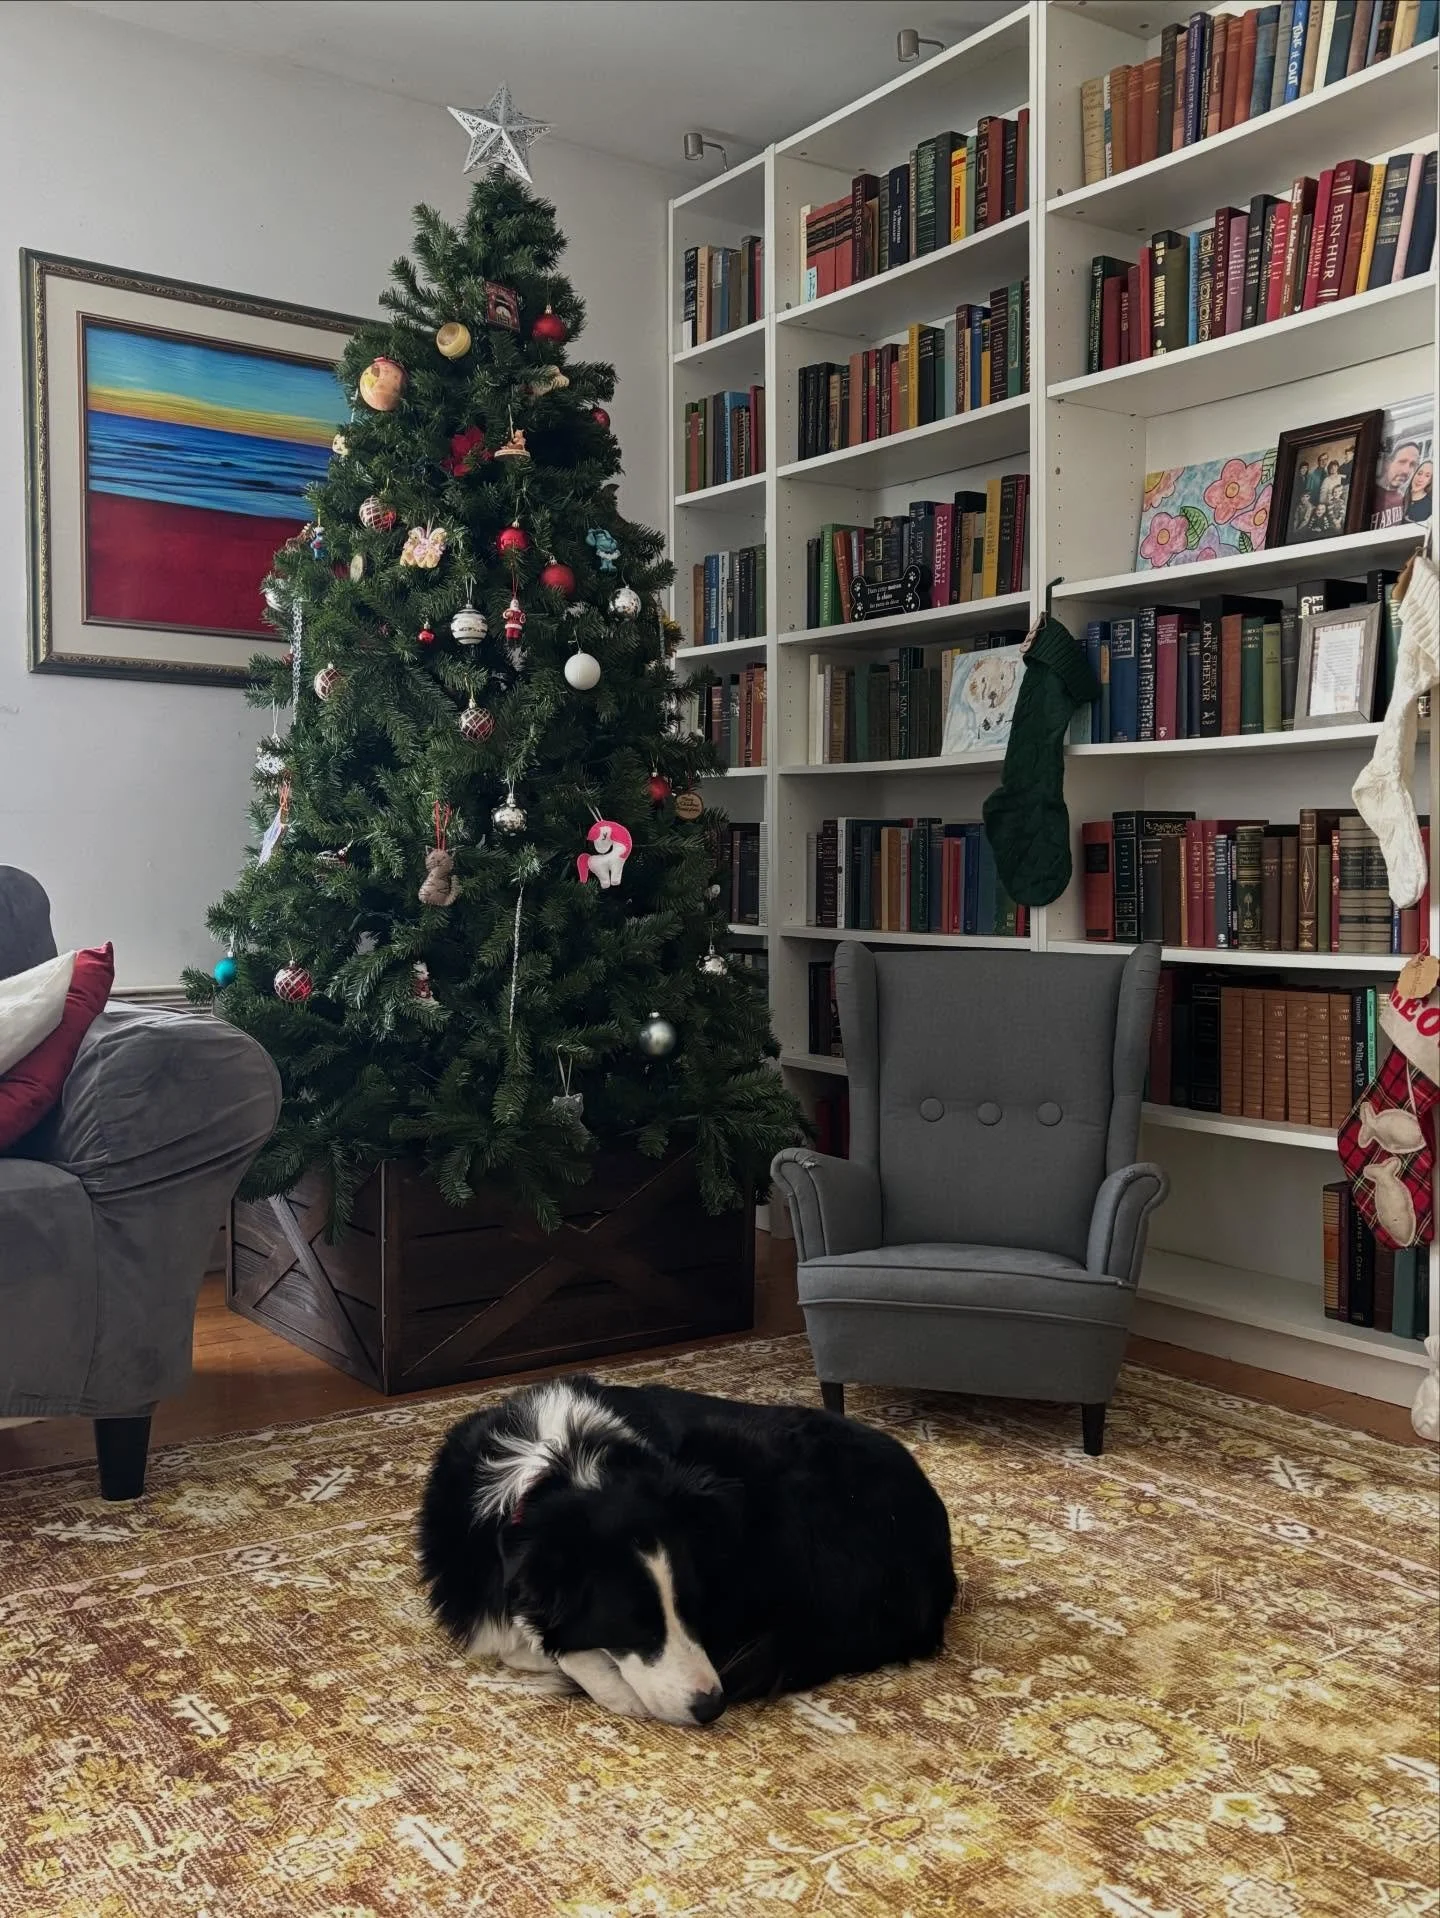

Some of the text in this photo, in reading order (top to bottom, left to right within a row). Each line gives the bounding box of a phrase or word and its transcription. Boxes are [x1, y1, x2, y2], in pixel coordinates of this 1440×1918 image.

[1287, 60, 1299, 87] OUT
[854, 182, 862, 208] THE
[853, 209, 862, 239] ROBE
[1216, 215, 1224, 250] ESSAYS
[1288, 229, 1296, 246] Eden
[1322, 202, 1344, 280] BEN-HUR
[1216, 254, 1223, 267] OF
[1284, 247, 1294, 275] Express
[1214, 292, 1223, 322] White
[933, 515, 943, 586] CATHEDRAL
[1201, 620, 1211, 701] JOHN CHEEVER
[899, 695, 907, 717] KIM
[1211, 689, 1217, 701] OF
[1355, 1069, 1364, 1091] Up
[1354, 1255, 1362, 1280] GRASS
